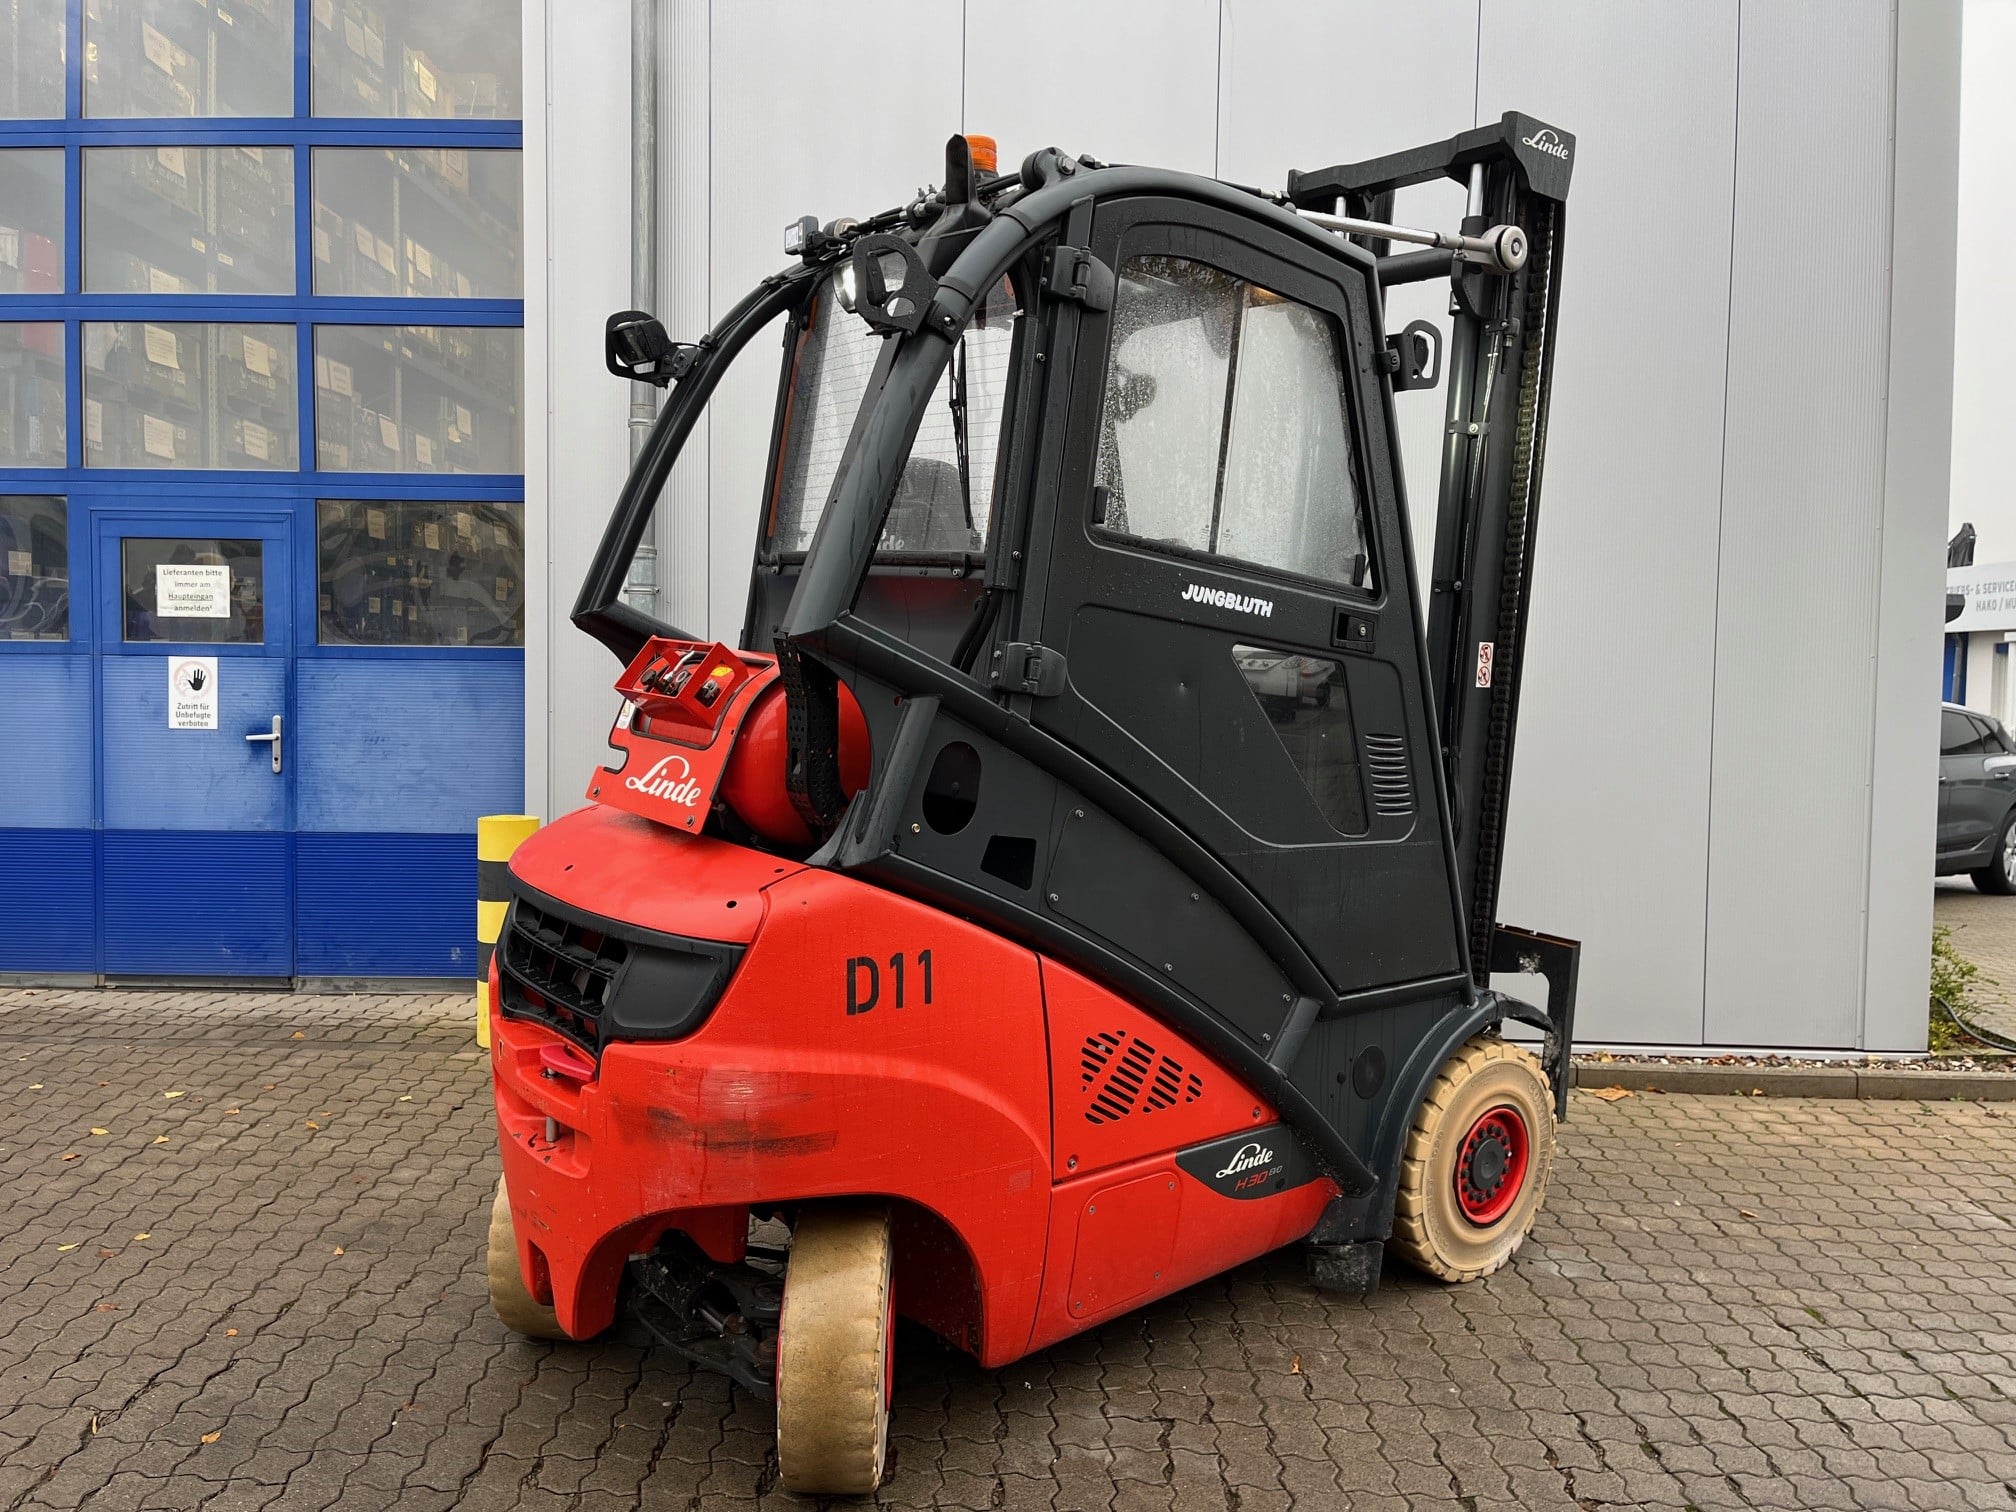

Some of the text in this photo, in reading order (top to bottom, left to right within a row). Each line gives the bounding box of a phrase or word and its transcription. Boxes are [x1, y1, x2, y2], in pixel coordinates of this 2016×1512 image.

[1522, 129, 1569, 160] Linde
[1181, 583, 1274, 618] JUNGBLUTH
[1976, 599, 1996, 612] HAKO
[175, 711, 212, 720] Unbefugte
[176, 702, 199, 710] Zutritt
[624, 754, 702, 808] Linde
[846, 948, 933, 1016] D11
[1215, 1142, 1274, 1179] Linde
[1234, 1170, 1269, 1192] H30
